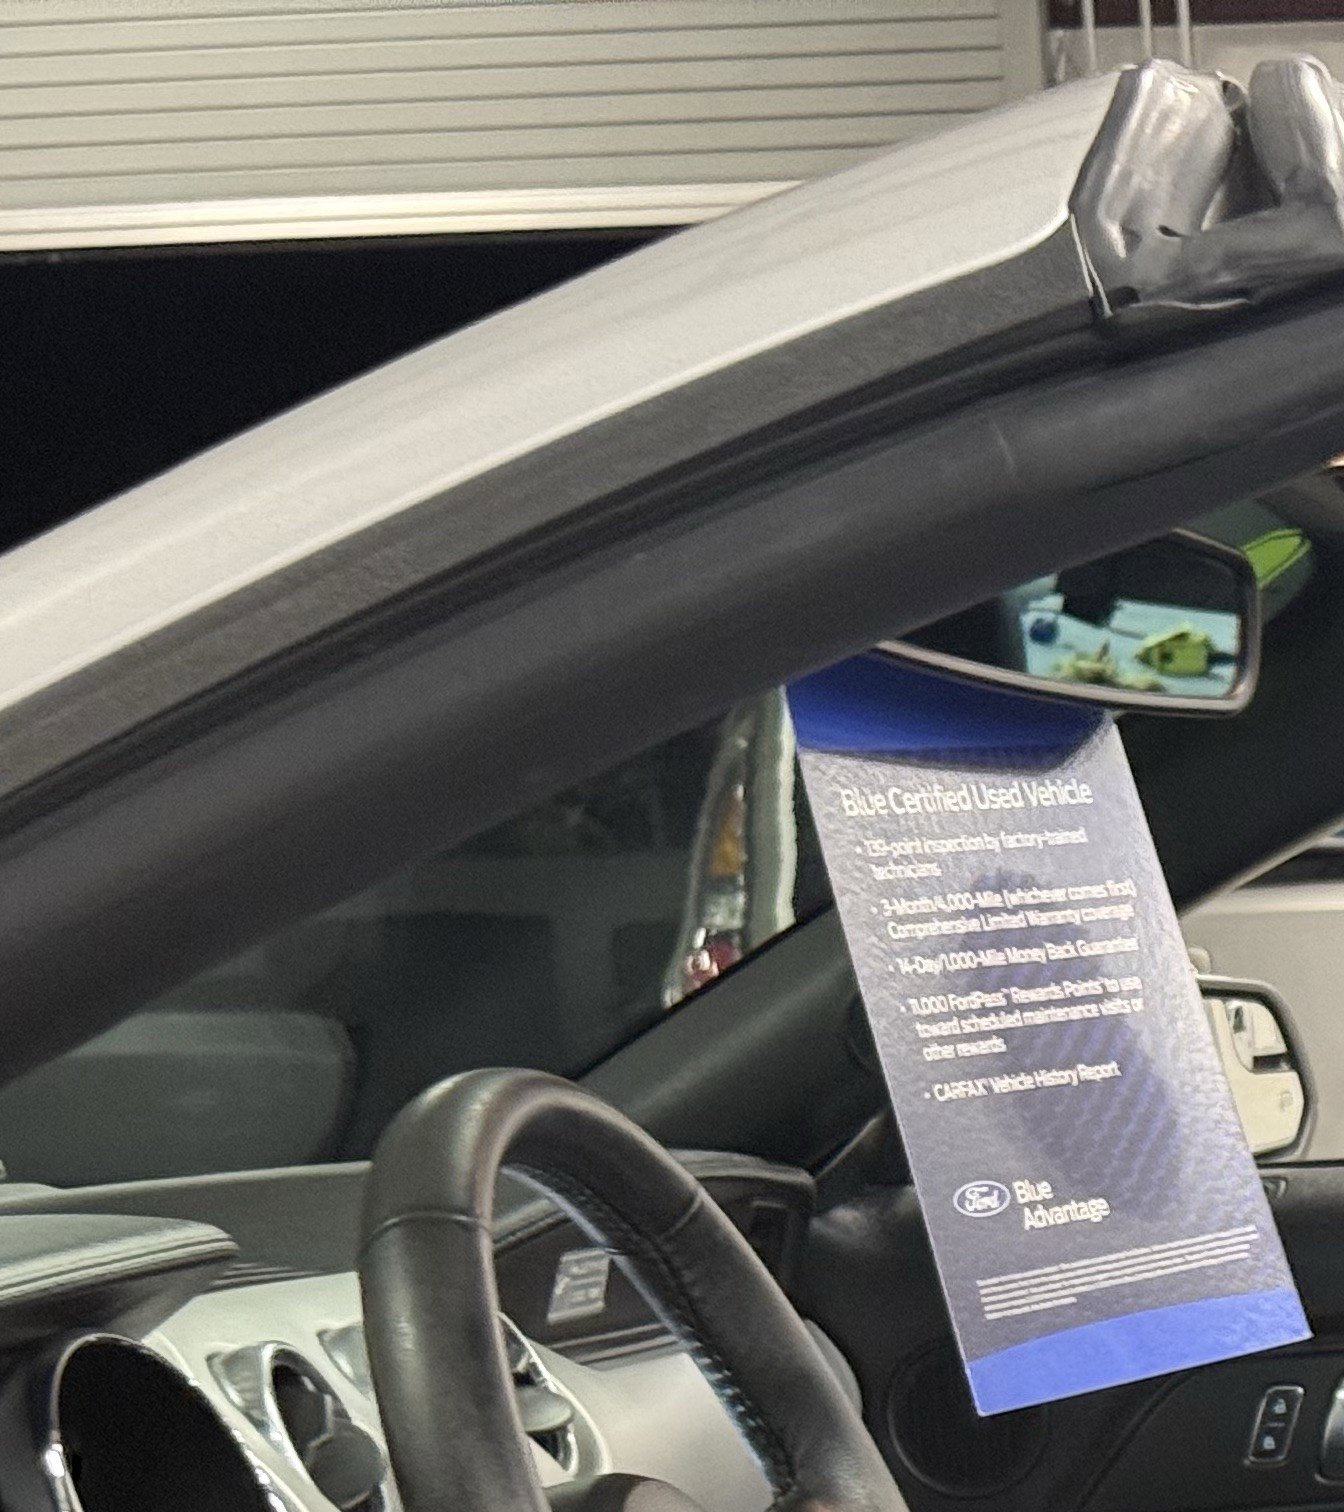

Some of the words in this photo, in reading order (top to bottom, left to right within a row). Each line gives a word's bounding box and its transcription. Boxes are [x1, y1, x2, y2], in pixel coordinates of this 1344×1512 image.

[841, 788, 888, 816] Blue
[887, 783, 974, 815] Certified
[971, 781, 1024, 810] Used
[1021, 779, 1094, 807] Vehicle
[886, 916, 981, 940] Comprehensive
[980, 911, 1027, 931] Limited
[1025, 908, 1081, 926] Warranty
[1006, 947, 1047, 964] Money
[1044, 941, 1078, 961] Back
[1010, 983, 1066, 1004] Rewards
[1105, 977, 1120, 993] to
[915, 1016, 961, 1038] toward
[960, 1009, 1023, 1033] scheduled
[1022, 1002, 1100, 1026] maintenance
[1130, 997, 1144, 1012] or
[923, 1043, 956, 1062] other
[988, 1071, 1036, 1094] Vehicle
[1033, 1067, 1078, 1087] History
[1077, 1060, 1123, 1082] Report
[1012, 1179, 1053, 1204] Blue
[1023, 1198, 1111, 1230] Advantage
